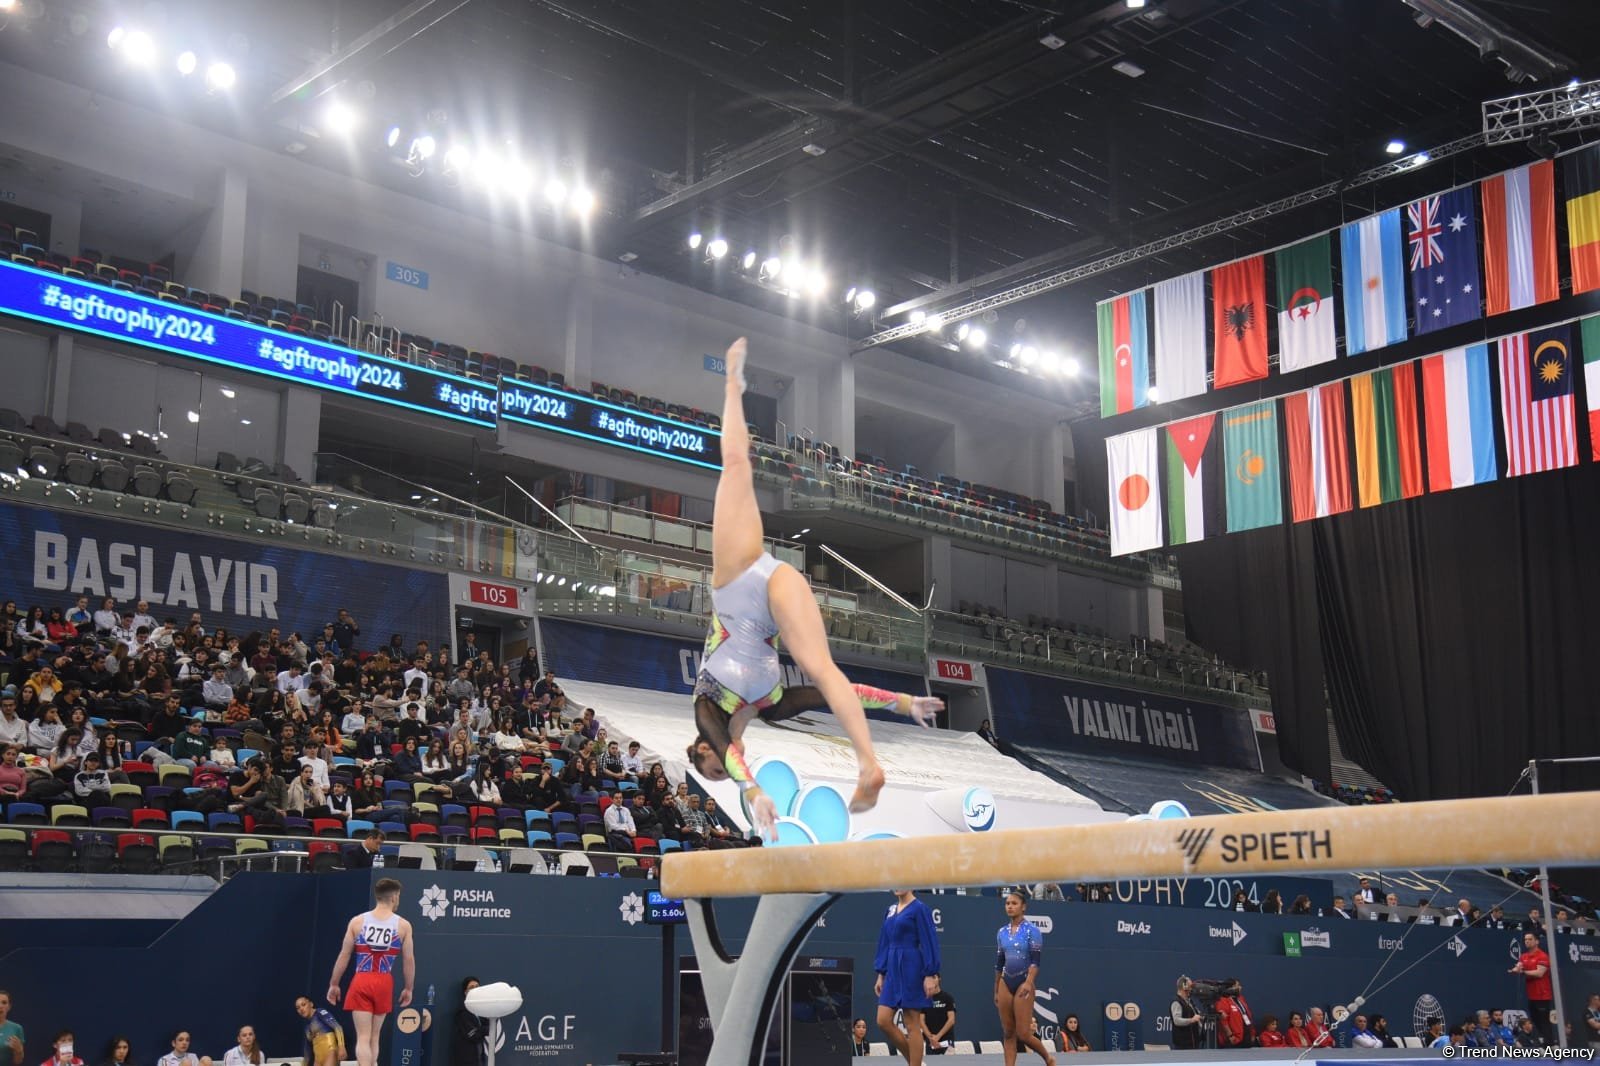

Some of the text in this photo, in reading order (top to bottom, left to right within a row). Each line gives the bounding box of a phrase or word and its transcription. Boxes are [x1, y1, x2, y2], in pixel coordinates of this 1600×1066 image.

[395, 266, 420, 285] 305
[43, 285, 216, 345] #agftrophy2024
[259, 338, 402, 391] #agftrophy2024
[598, 411, 704, 453] #agftrophy2024
[481, 586, 507, 604] 105
[944, 663, 965, 678] 104
[1063, 695, 1142, 743] YALNIZ
[1220, 829, 1332, 863] SPIETH
[453, 889, 494, 902] PASHA
[452, 905, 512, 918] Insurance
[366, 926, 392, 944] 276
[1117, 920, 1151, 936] Day.Az
[515, 1014, 577, 1042] AGF
